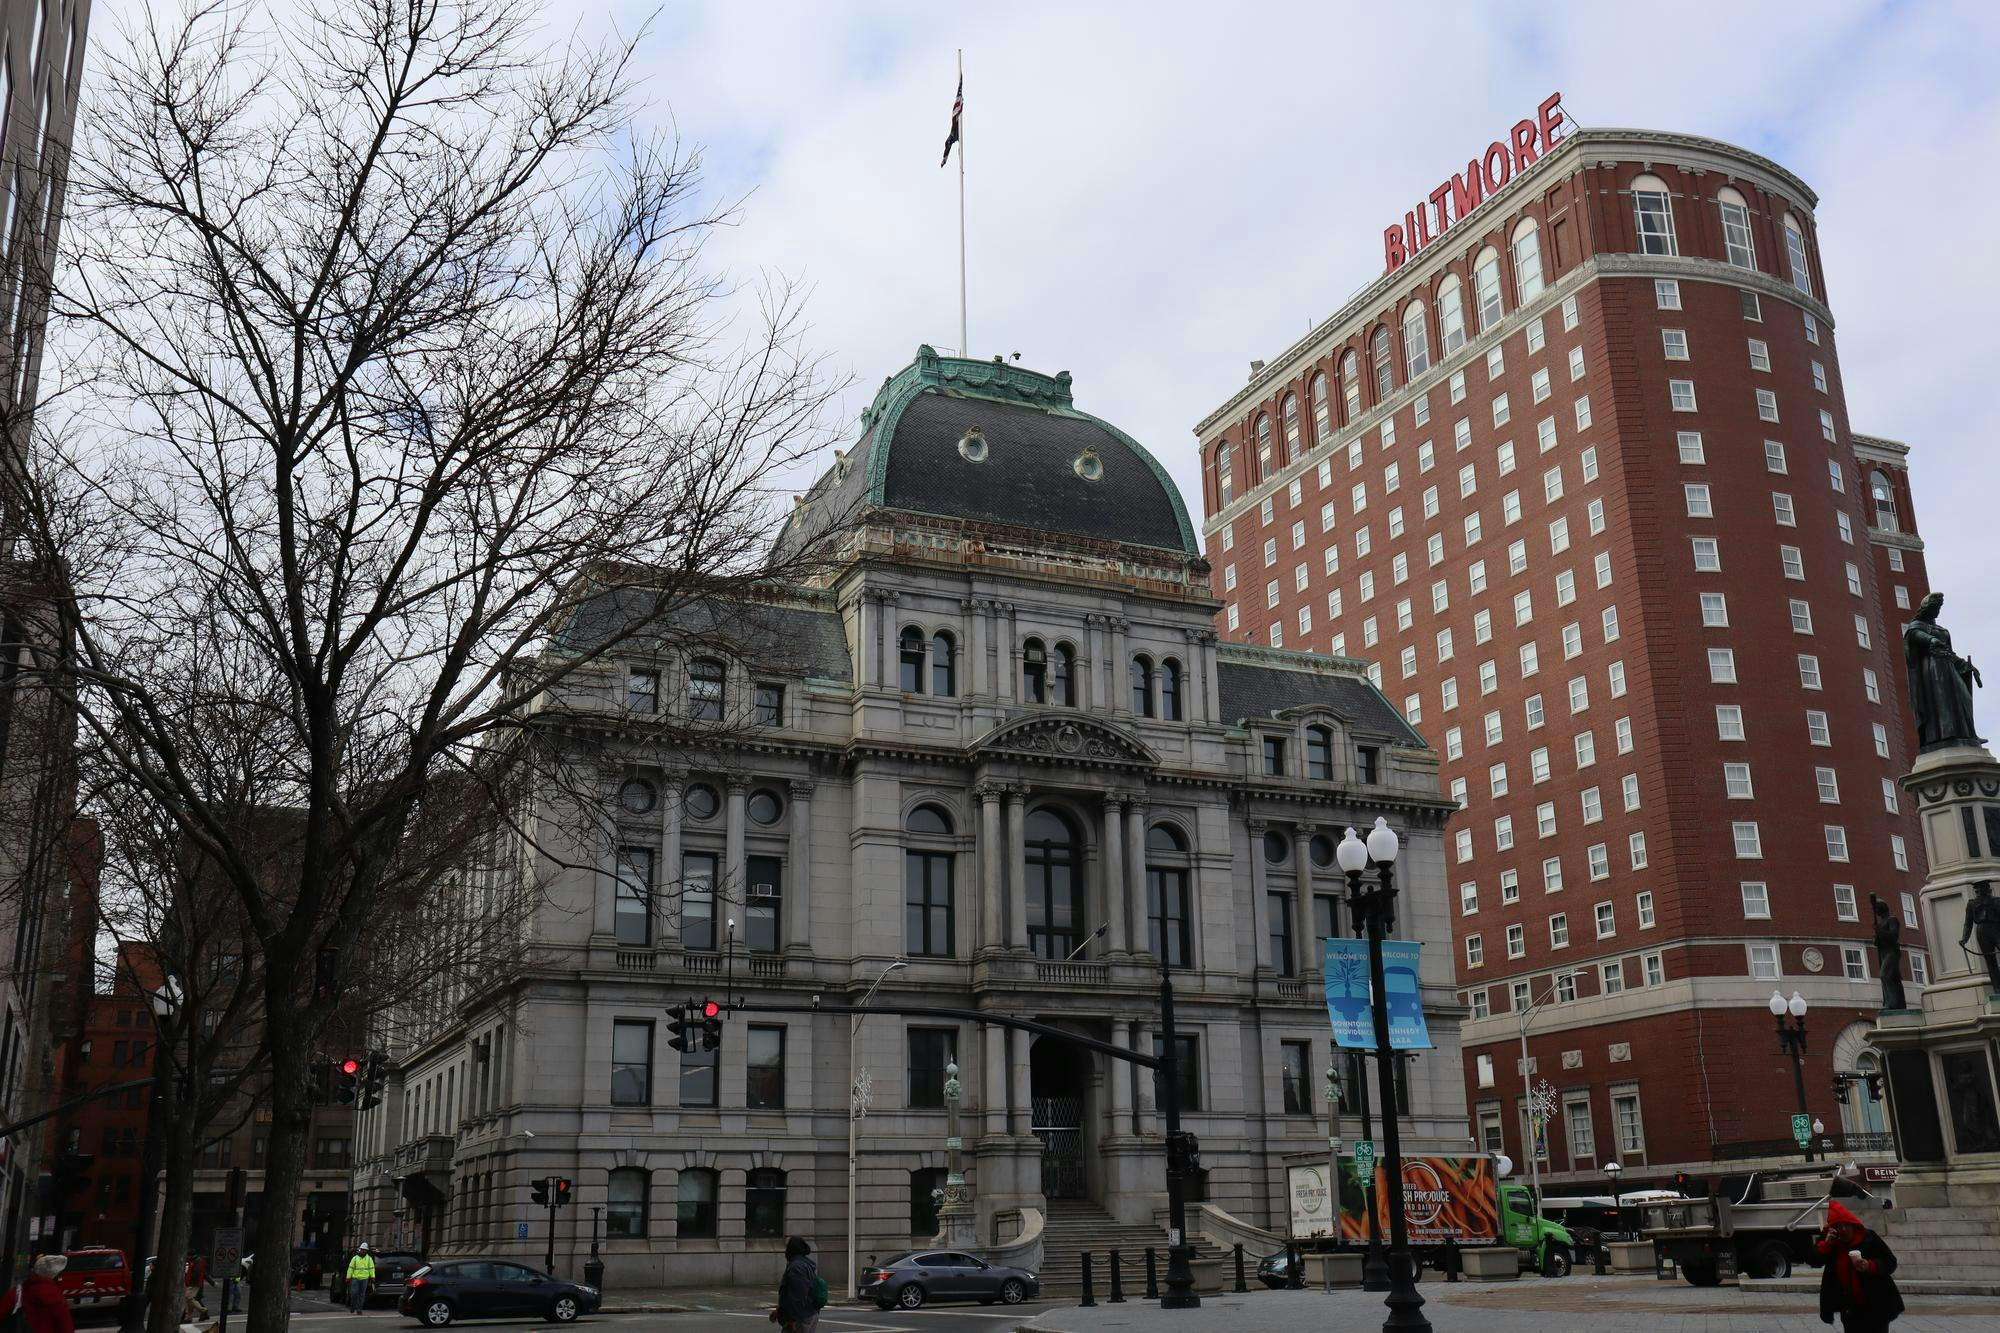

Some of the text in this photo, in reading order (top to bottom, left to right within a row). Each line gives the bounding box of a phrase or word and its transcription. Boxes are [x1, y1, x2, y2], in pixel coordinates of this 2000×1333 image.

[1384, 92, 1565, 274] BILTMORE
[1402, 1190, 1450, 1202] SH PRODUCE
